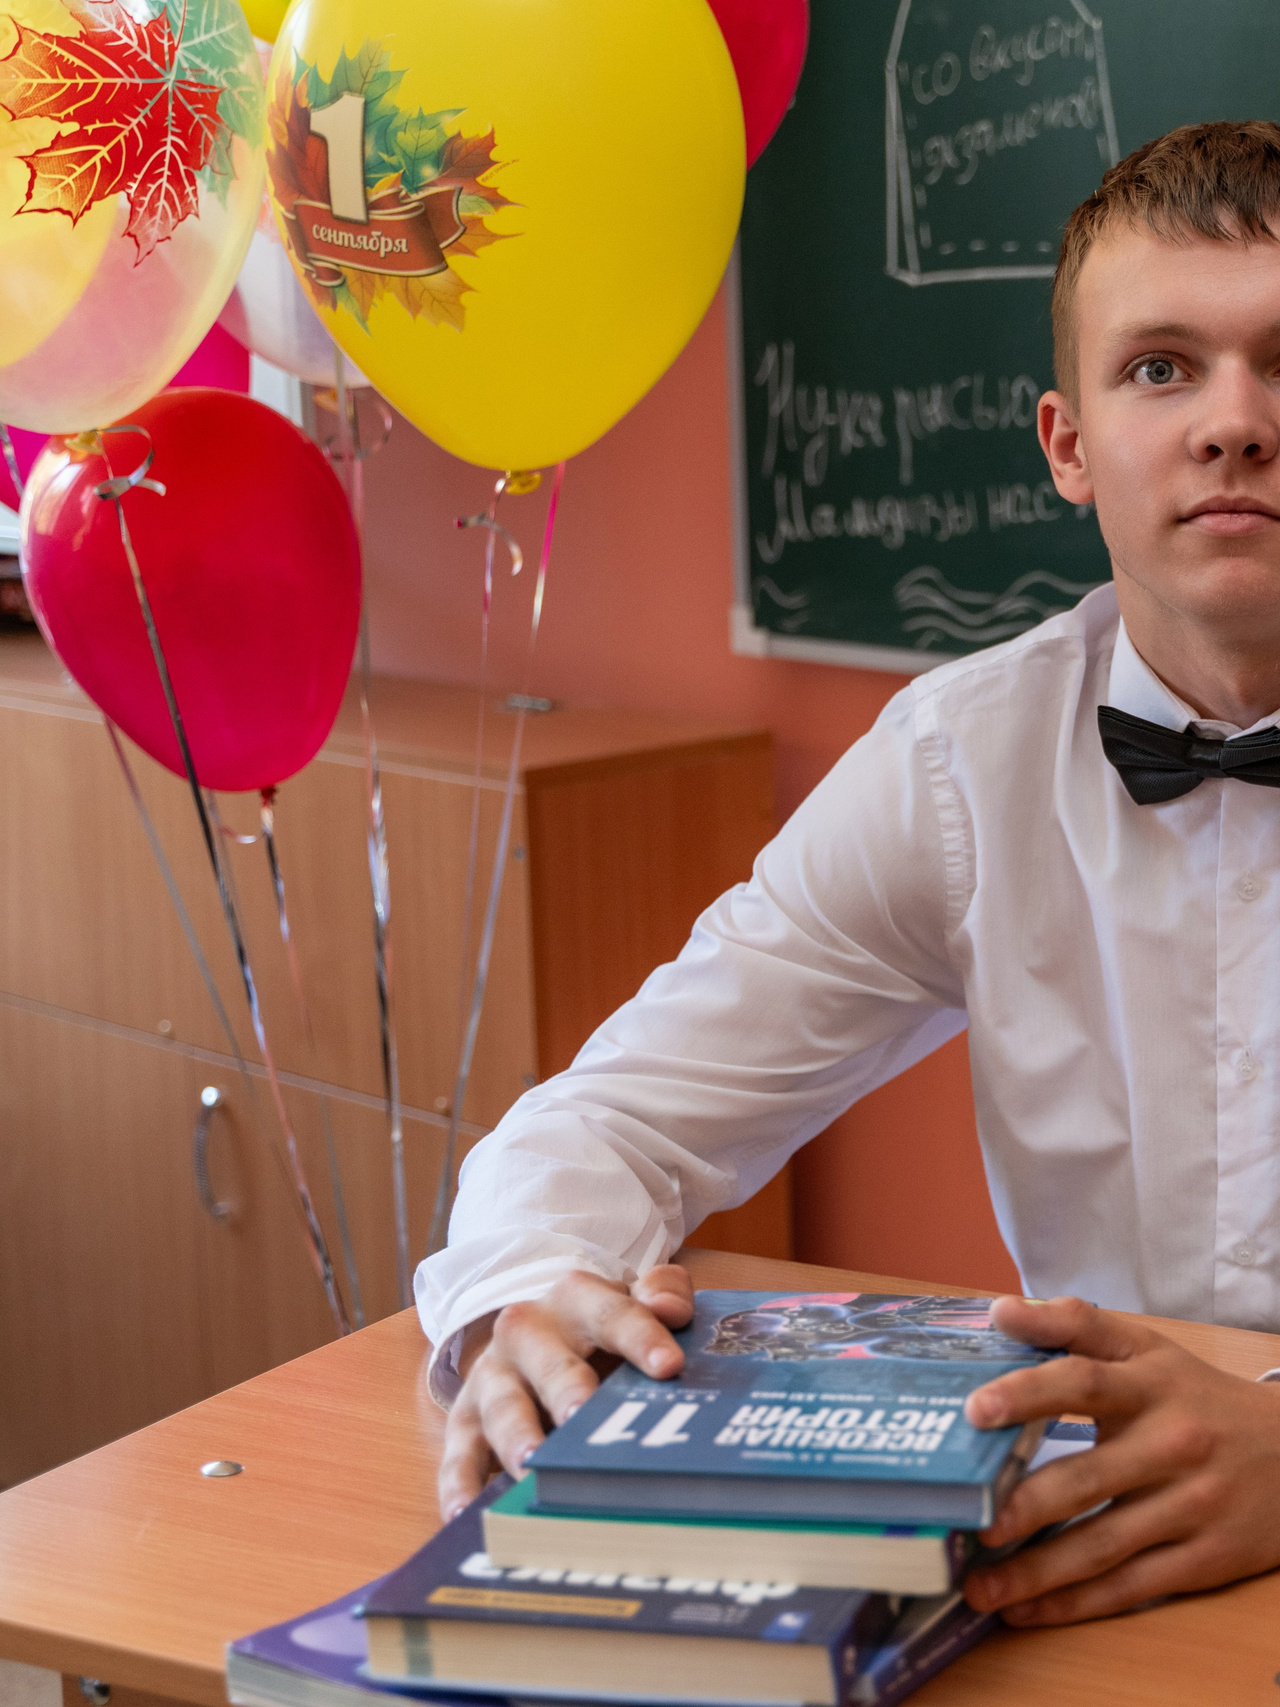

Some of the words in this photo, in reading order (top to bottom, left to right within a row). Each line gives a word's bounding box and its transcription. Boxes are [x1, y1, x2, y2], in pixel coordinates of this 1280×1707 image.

[912, 51, 961, 105] со
[310, 91, 369, 222] 1
[312, 223, 409, 258] сентября
[586, 1401, 700, 1446] 11
[714, 1424, 945, 1452] ВСЕОБЩАЯ
[728, 1404, 958, 1432] ИСТОРИЯ
